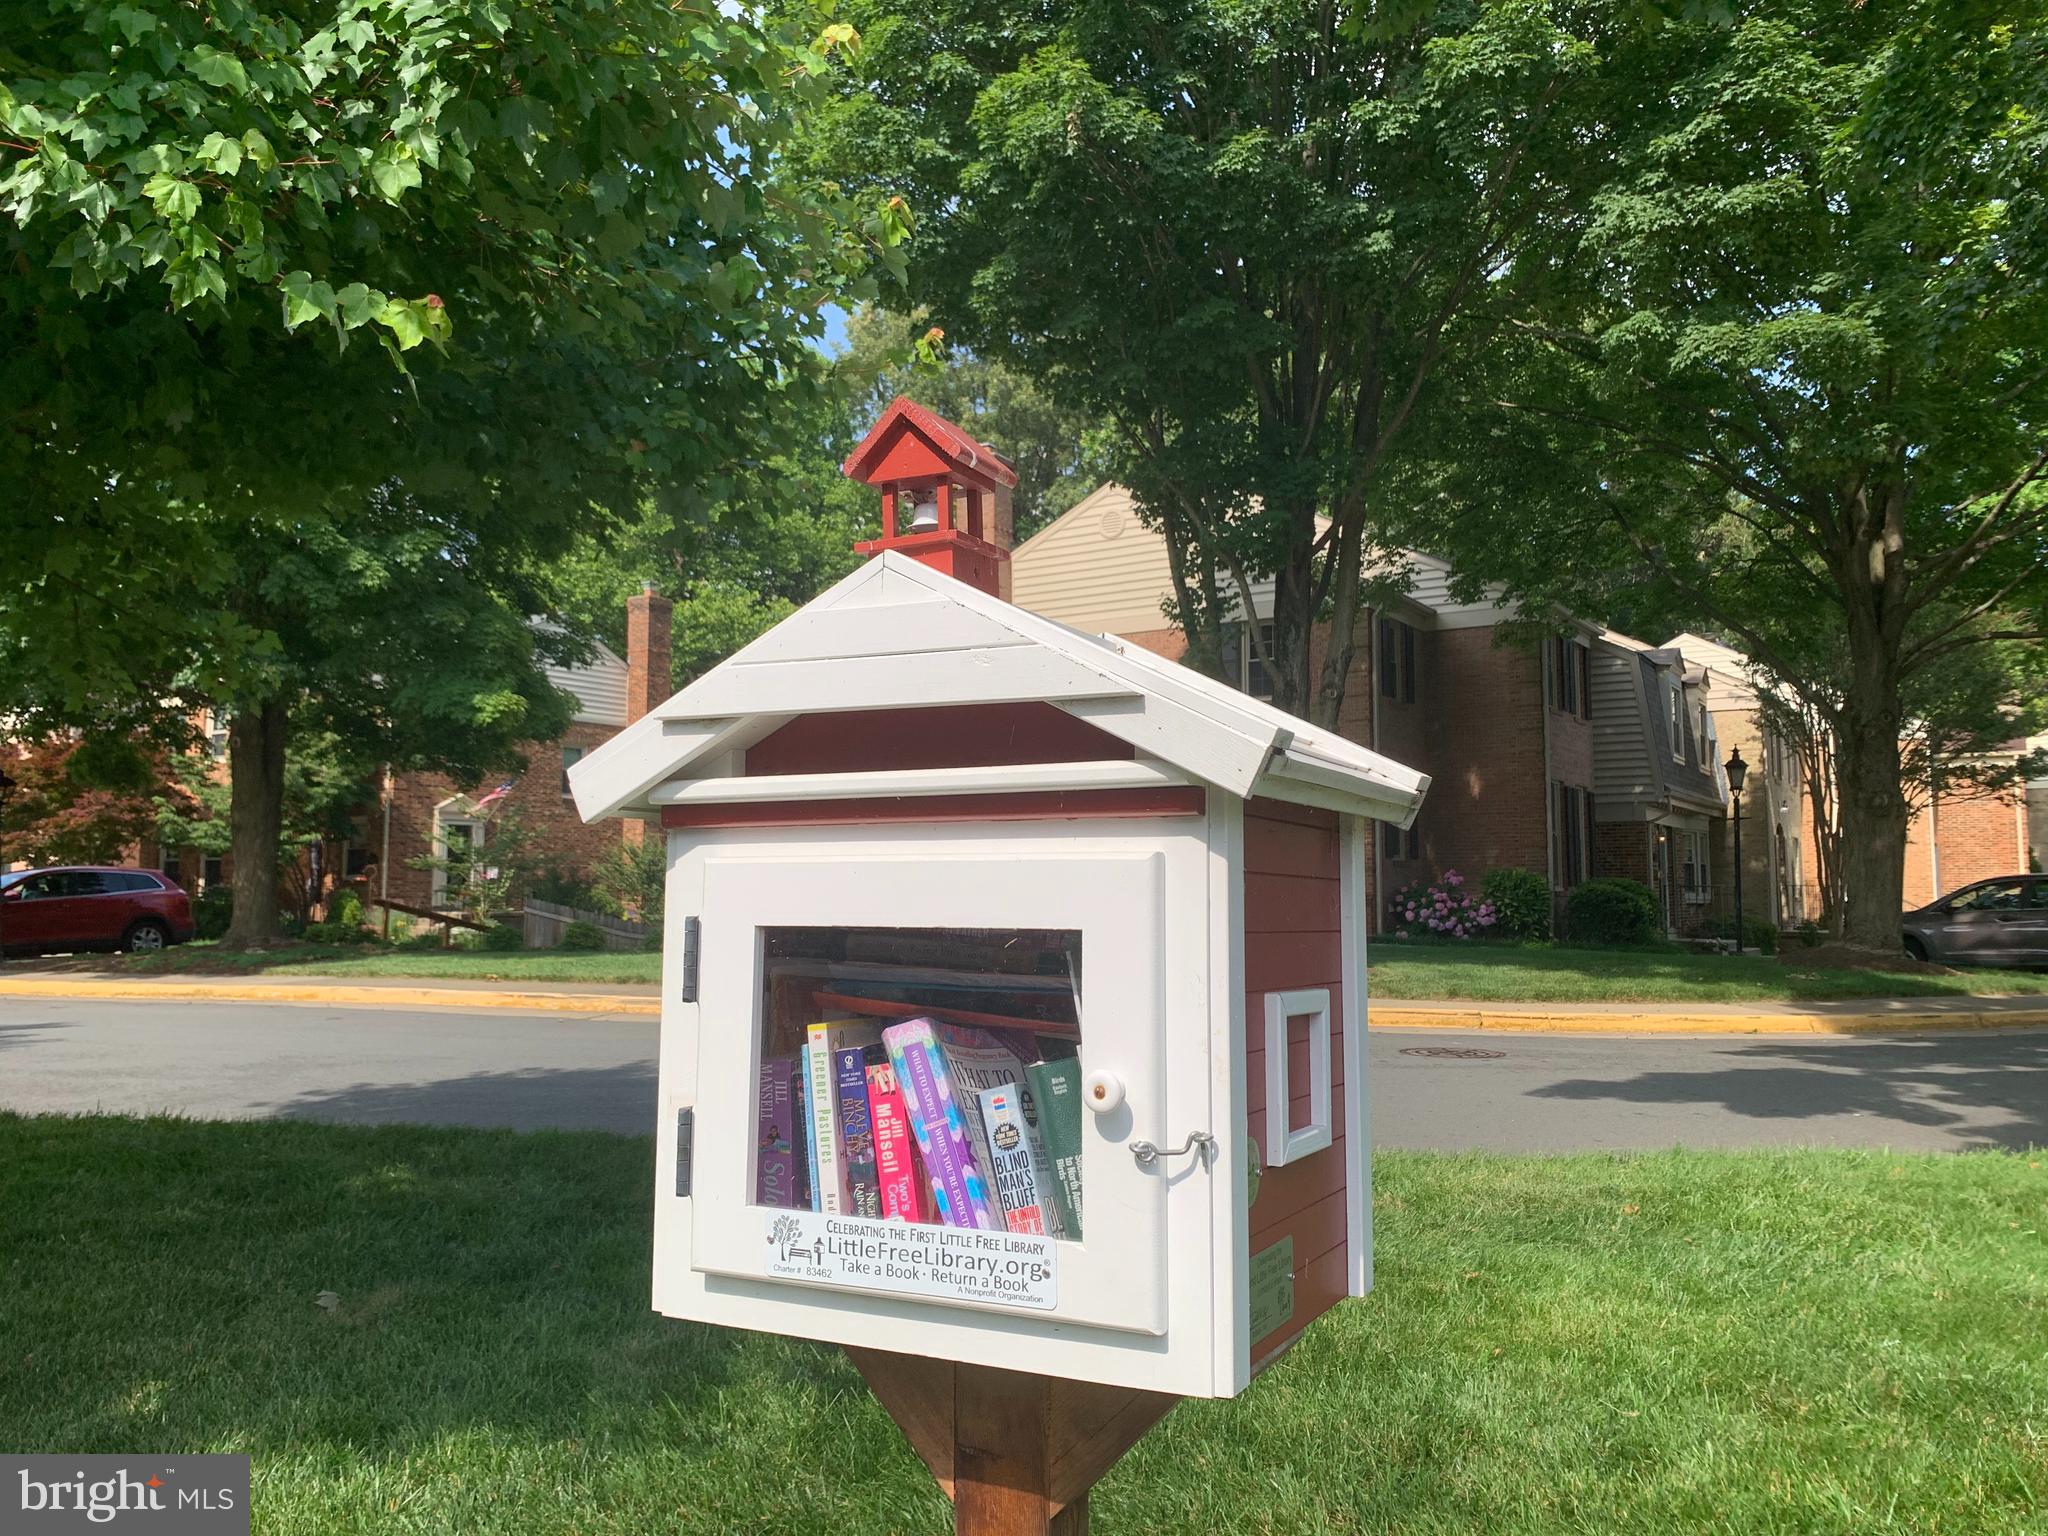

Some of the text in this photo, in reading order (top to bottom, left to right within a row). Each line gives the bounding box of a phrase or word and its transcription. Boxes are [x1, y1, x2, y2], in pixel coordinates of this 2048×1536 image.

[911, 1049, 924, 1077] WHAT
[921, 1086, 938, 1120] EXPECT
[950, 1059, 1016, 1089] WHAT TO
[761, 1064, 774, 1121] MANSELL
[775, 1080, 788, 1104] JILL
[813, 1051, 832, 1164] Greener Pastures
[842, 1098, 858, 1153] BINCHY
[854, 1099, 870, 1152] MAEVE
[890, 1117, 904, 1139] Jill
[875, 1103, 899, 1174] Mansell
[934, 1127, 949, 1157] WHEN
[943, 1154, 957, 1190] YOU'RE
[994, 1150, 1030, 1175] BLIND
[1055, 1158, 1066, 1181] Birds
[1064, 1156, 1073, 1167] to
[898, 1173, 911, 1212] Two's
[998, 1168, 1034, 1193] MAN'S
[1067, 1168, 1081, 1192] North
[854, 1183, 866, 1206] RAIN
[865, 1192, 876, 1217] NIGH
[887, 1183, 900, 1219] Com
[1002, 1187, 1036, 1212] BLUFF
[1007, 1205, 1041, 1222] THE UNTOLD
[888, 1228, 906, 1241] THE
[910, 1228, 936, 1244] FIRST
[940, 1231, 972, 1248] LITTLE
[976, 1235, 1000, 1251] FREE
[1004, 1238, 1045, 1255] LIBRARY
[773, 1264, 796, 1274] Charter
[806, 1267, 833, 1279] 83462
[840, 1257, 1029, 1293] Take a Book Return a Book
[957, 1286, 1044, 1303] A Nonprofit Organization
